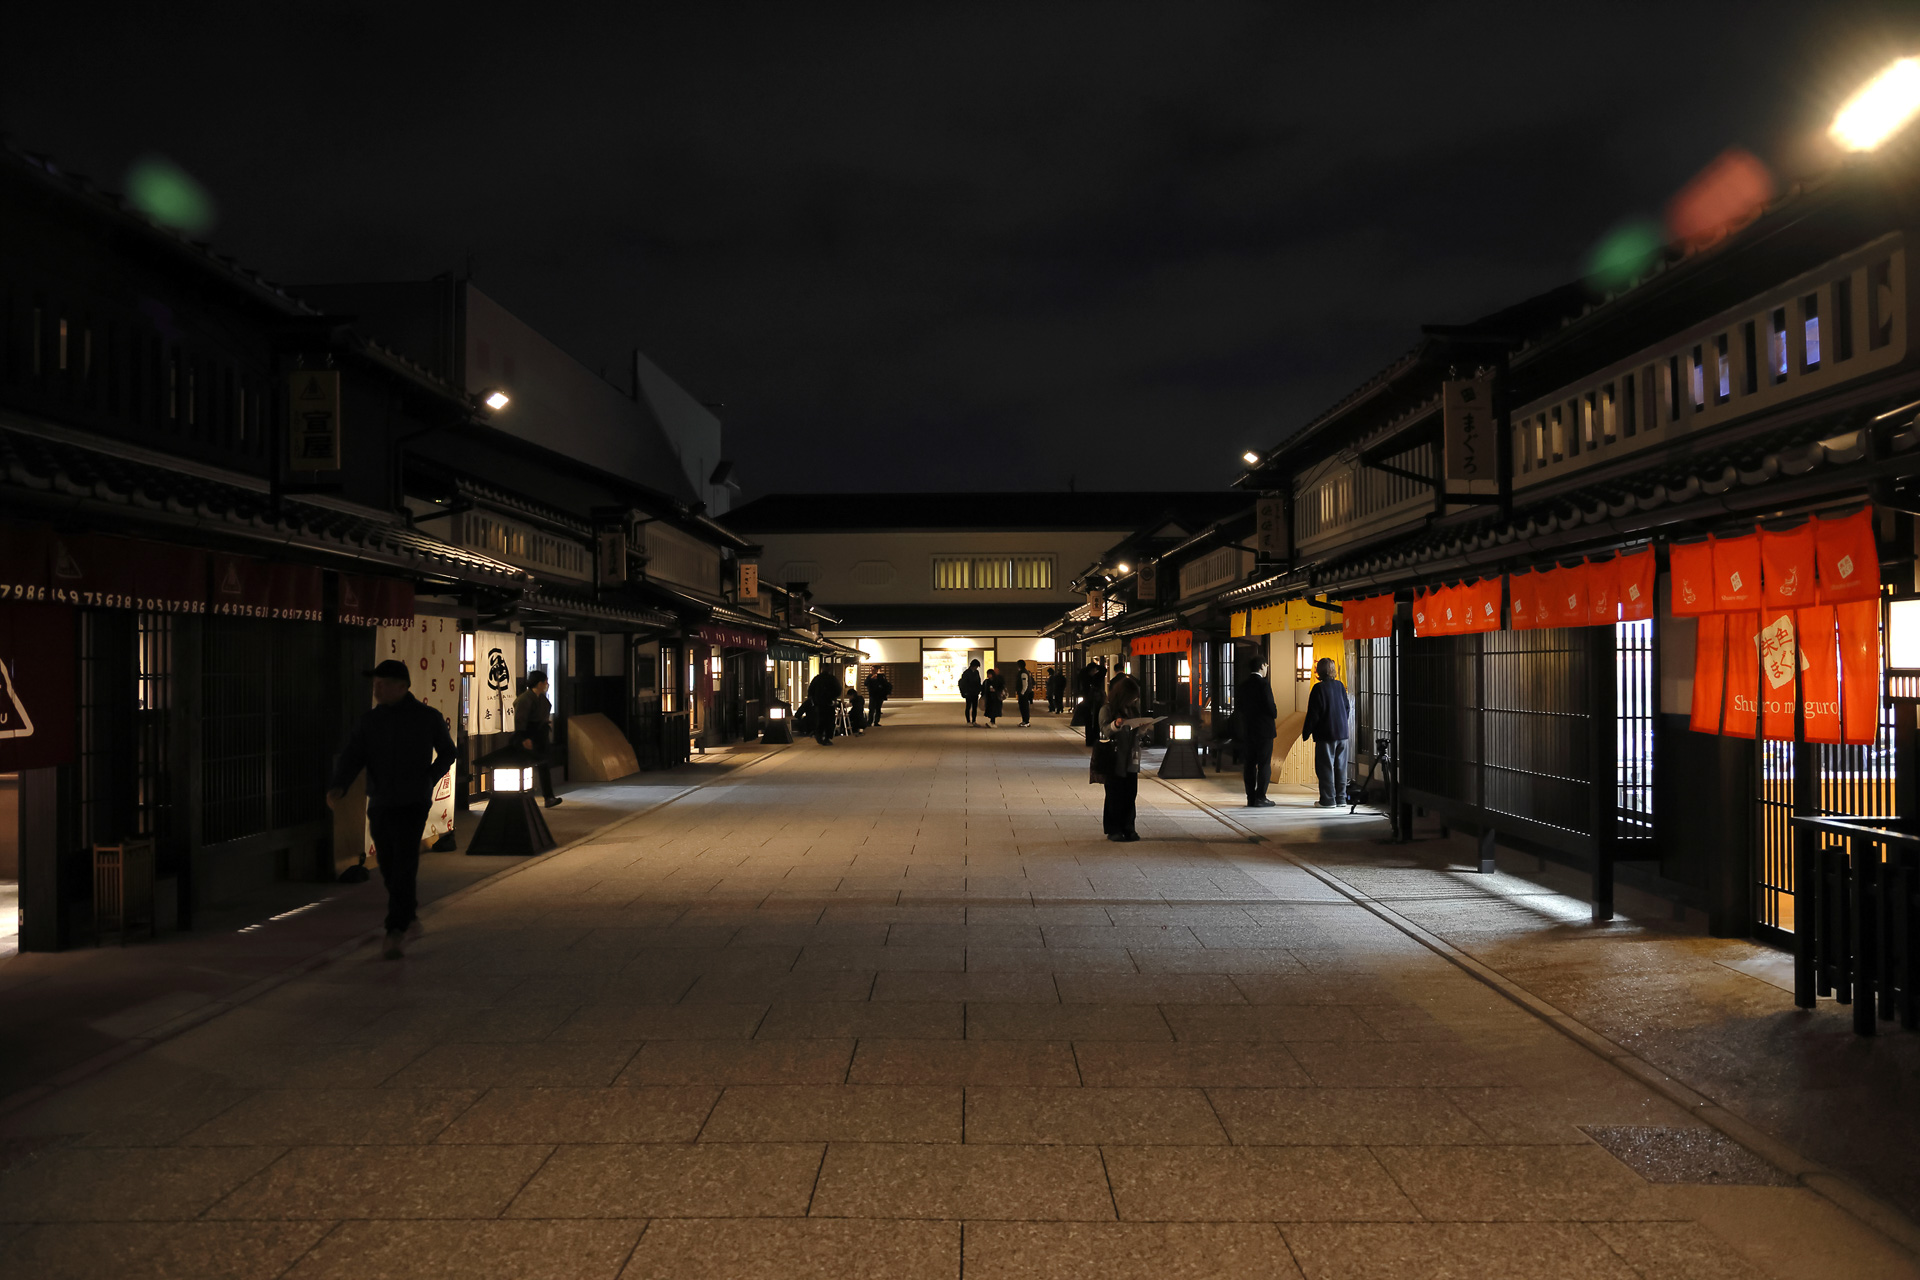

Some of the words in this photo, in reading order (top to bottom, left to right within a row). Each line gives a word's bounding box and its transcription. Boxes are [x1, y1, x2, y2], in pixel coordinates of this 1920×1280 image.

[1462, 412, 1479, 475] まぐろ
[1784, 701, 1839, 719] mguro
